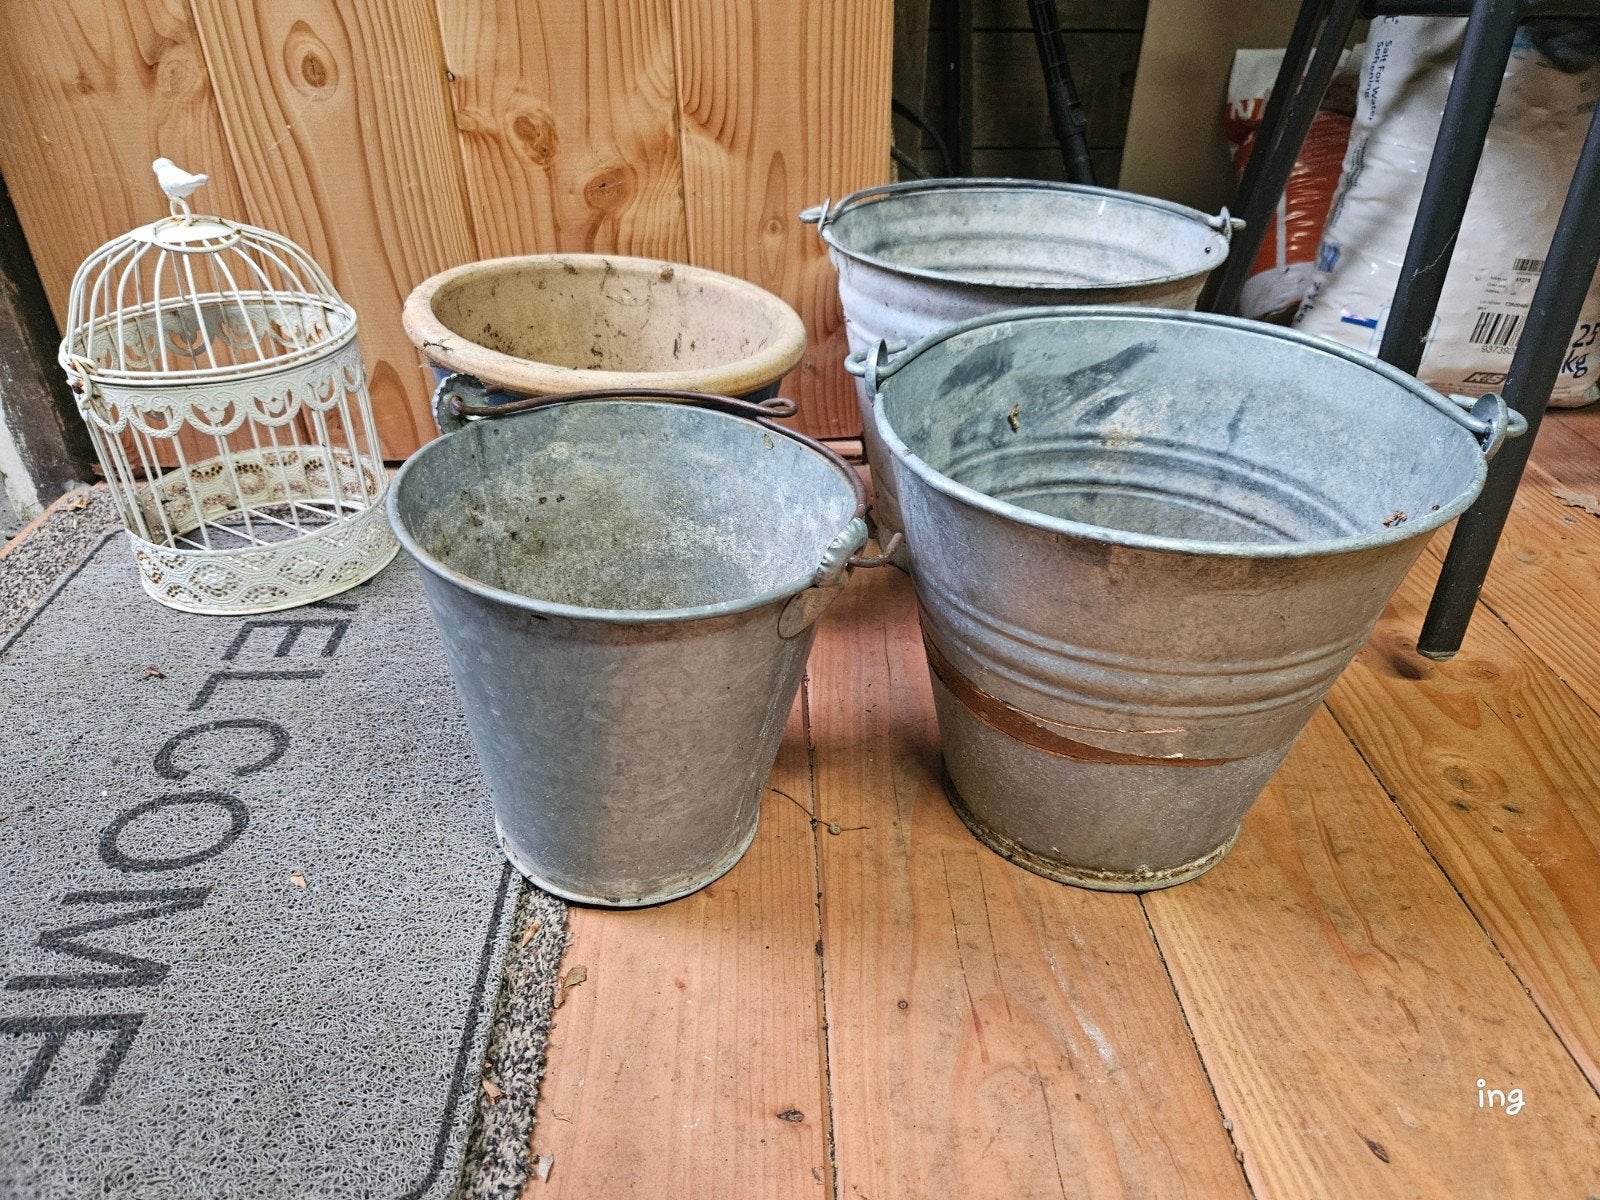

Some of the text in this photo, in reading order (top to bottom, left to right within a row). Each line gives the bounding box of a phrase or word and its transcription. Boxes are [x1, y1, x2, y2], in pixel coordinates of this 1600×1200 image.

[1379, 40, 1393, 63] Salt
[1364, 41, 1384, 99] Softening
[1375, 65, 1385, 83] For
[1572, 322, 1600, 348] 25
[1562, 349, 1591, 379] kg
[0, 578, 372, 1107] ELCOME
